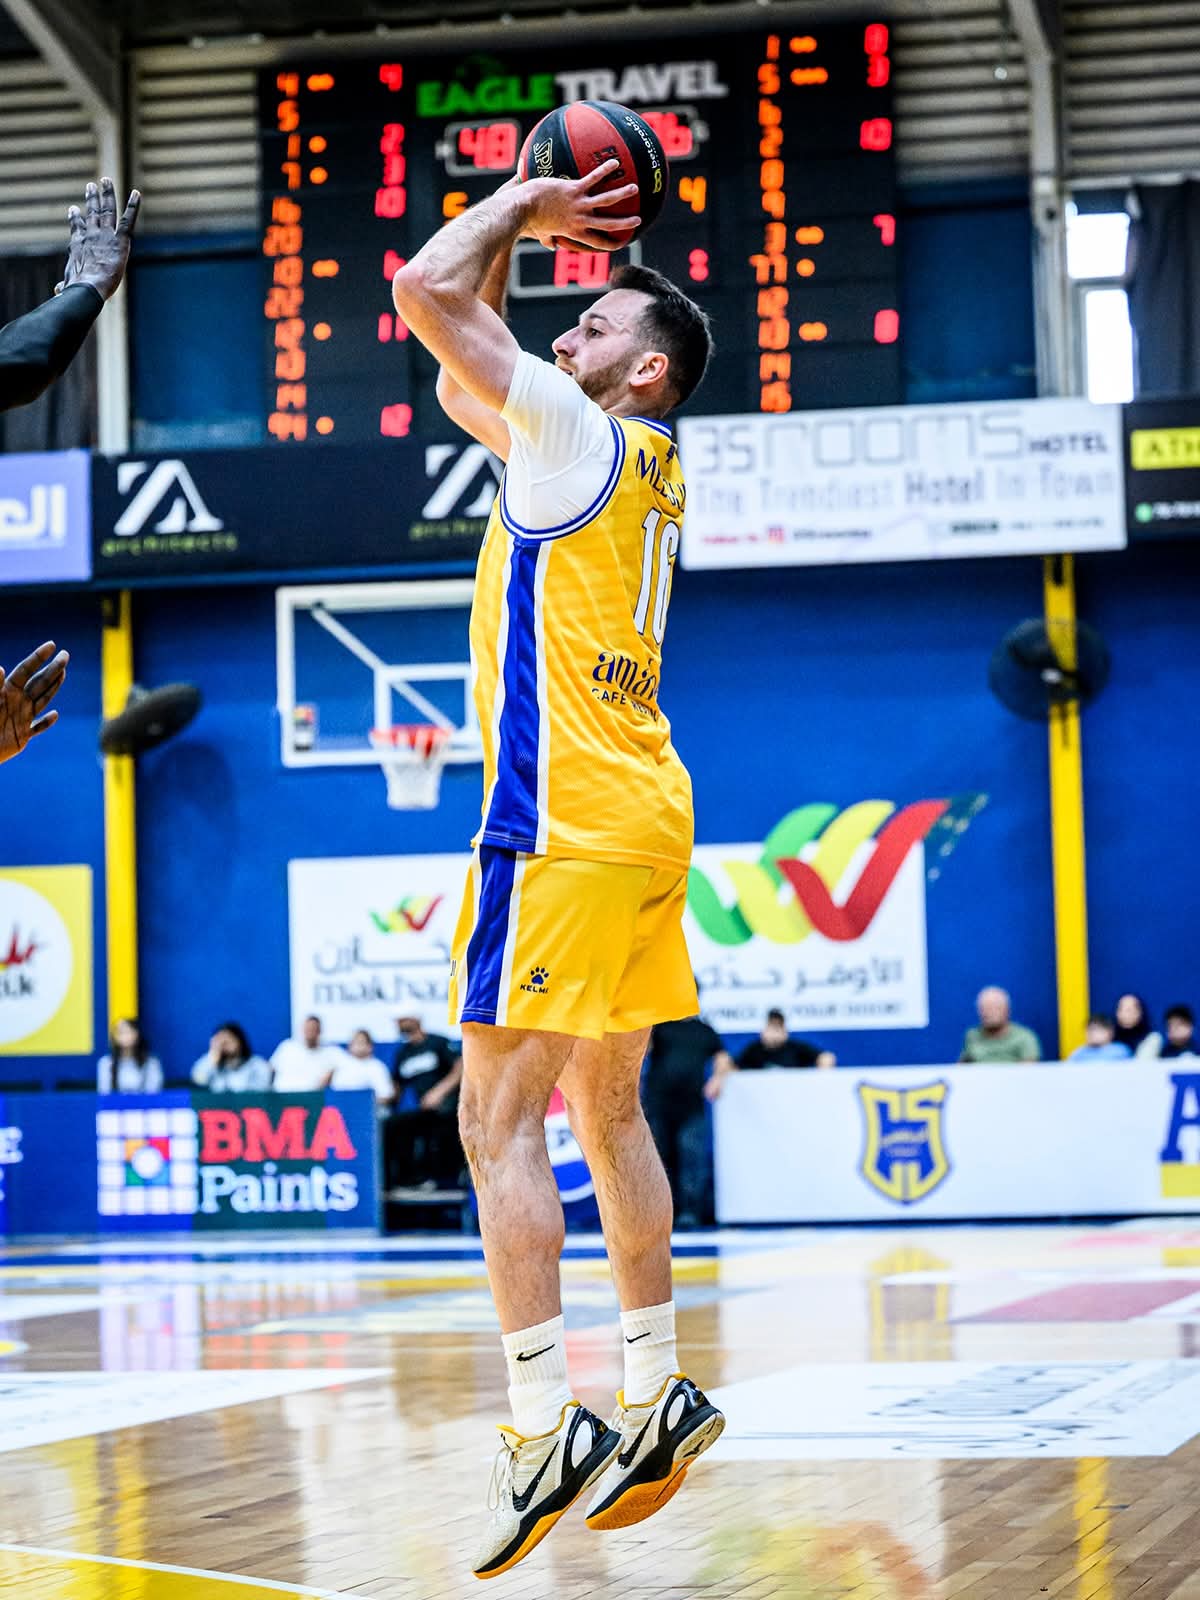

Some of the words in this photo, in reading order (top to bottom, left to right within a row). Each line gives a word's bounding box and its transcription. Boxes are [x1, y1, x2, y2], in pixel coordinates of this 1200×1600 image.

[416, 74, 555, 117] EAGLE
[554, 61, 730, 108] TRAVEL
[457, 122, 518, 169] 48
[678, 176, 707, 214] 4
[1028, 433, 1108, 453] HOTEL
[905, 470, 985, 504] Hotel
[198, 1105, 358, 1163] BMA
[199, 1161, 360, 1214] Paints
